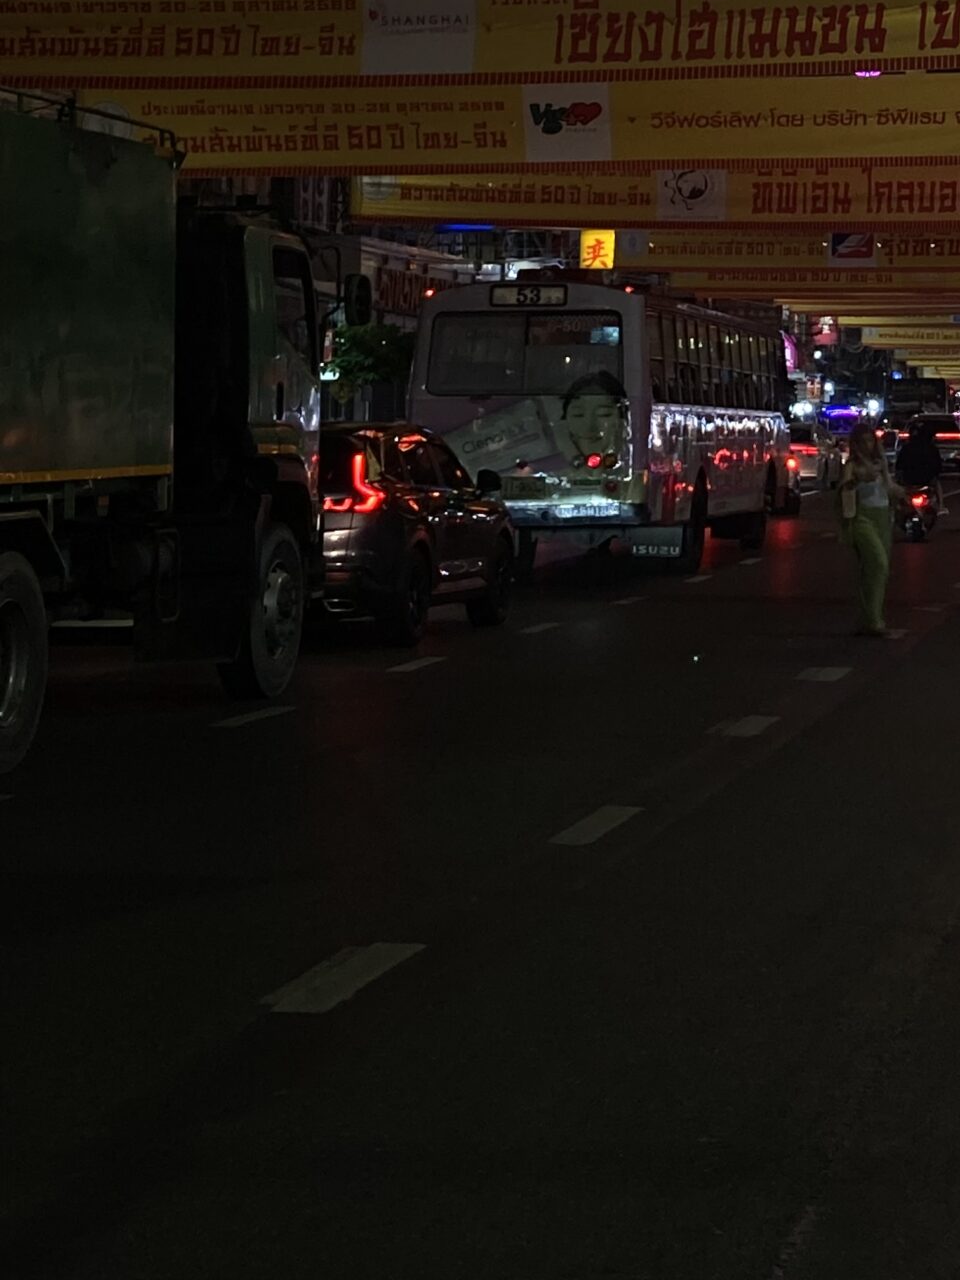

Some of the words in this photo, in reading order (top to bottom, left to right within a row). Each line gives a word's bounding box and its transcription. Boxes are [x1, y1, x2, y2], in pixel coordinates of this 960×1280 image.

[381, 14, 470, 27] SHANGHAI
[175, 27, 214, 57] 50
[221, 23, 241, 57] ปี
[248, 23, 356, 57] ไทย-จีน
[769, 109, 803, 127] โดย
[813, 106, 868, 127] บริษัท
[347, 125, 382, 151] 50
[386, 123, 405, 151] ปี
[410, 122, 507, 151] ไทย-จีน
[540, 185, 565, 204] 50
[516, 288, 541, 304] 53
[632, 544, 681, 556] ISUZU
